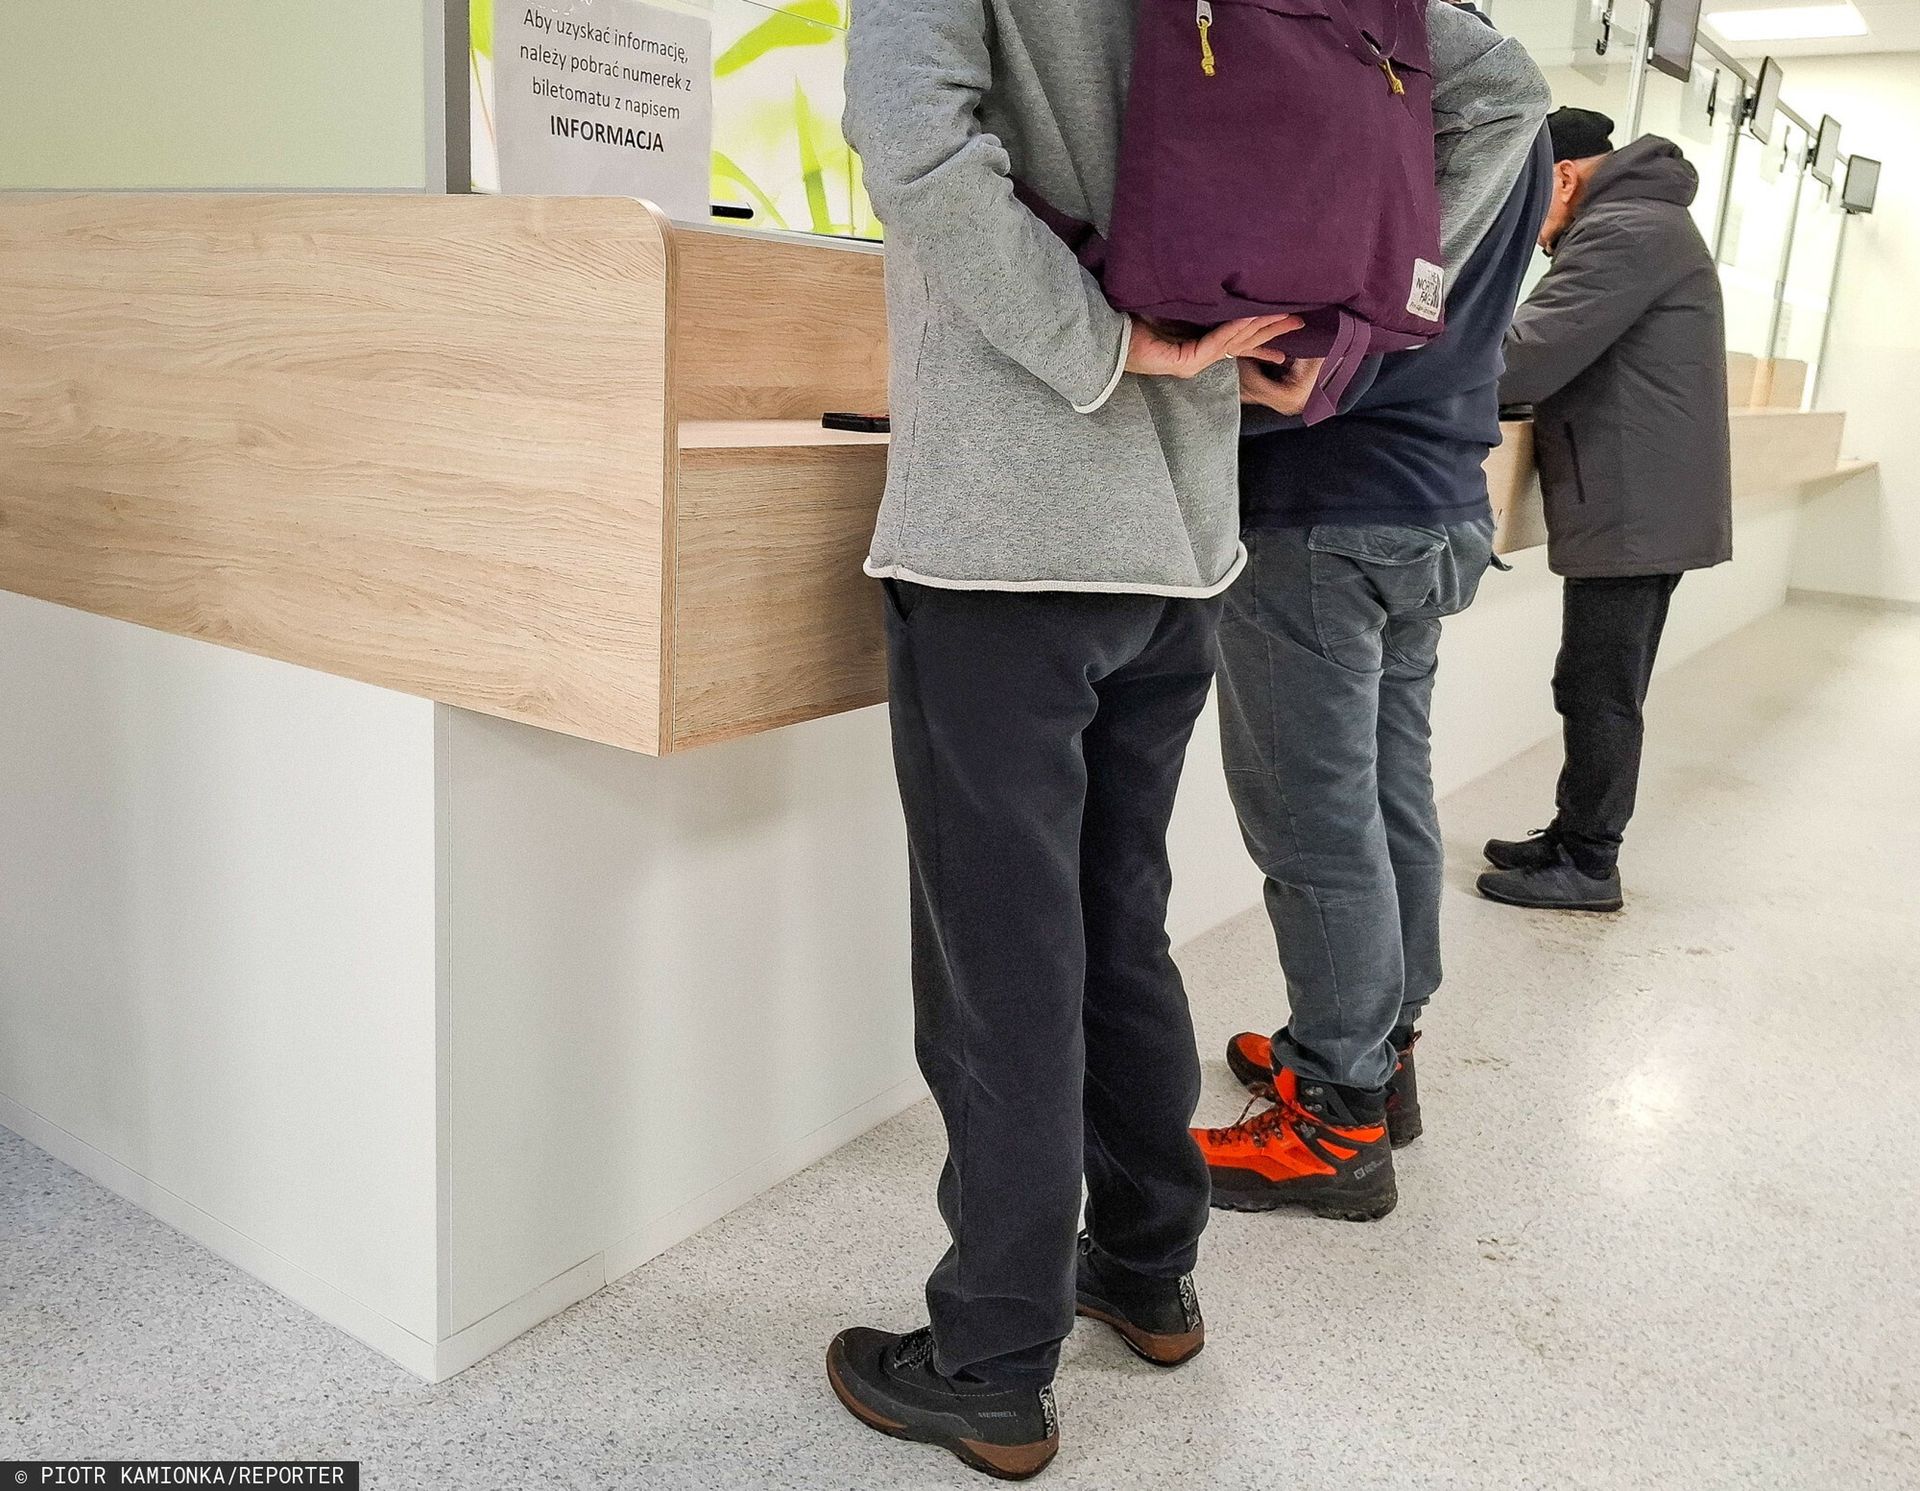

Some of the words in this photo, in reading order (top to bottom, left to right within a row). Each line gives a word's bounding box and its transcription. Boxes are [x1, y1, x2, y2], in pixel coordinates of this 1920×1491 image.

[523, 9, 552, 35] Aby
[556, 20, 611, 44] uzyskać
[614, 28, 688, 64] informację,
[520, 44, 567, 71] należy
[571, 54, 620, 78] pobrać
[623, 67, 682, 90] numerek
[685, 79, 691, 92] z
[532, 76, 610, 108] biletomatu
[615, 97, 621, 110] z
[625, 99, 680, 120] napisem
[550, 115, 664, 153] INFORMACJA
